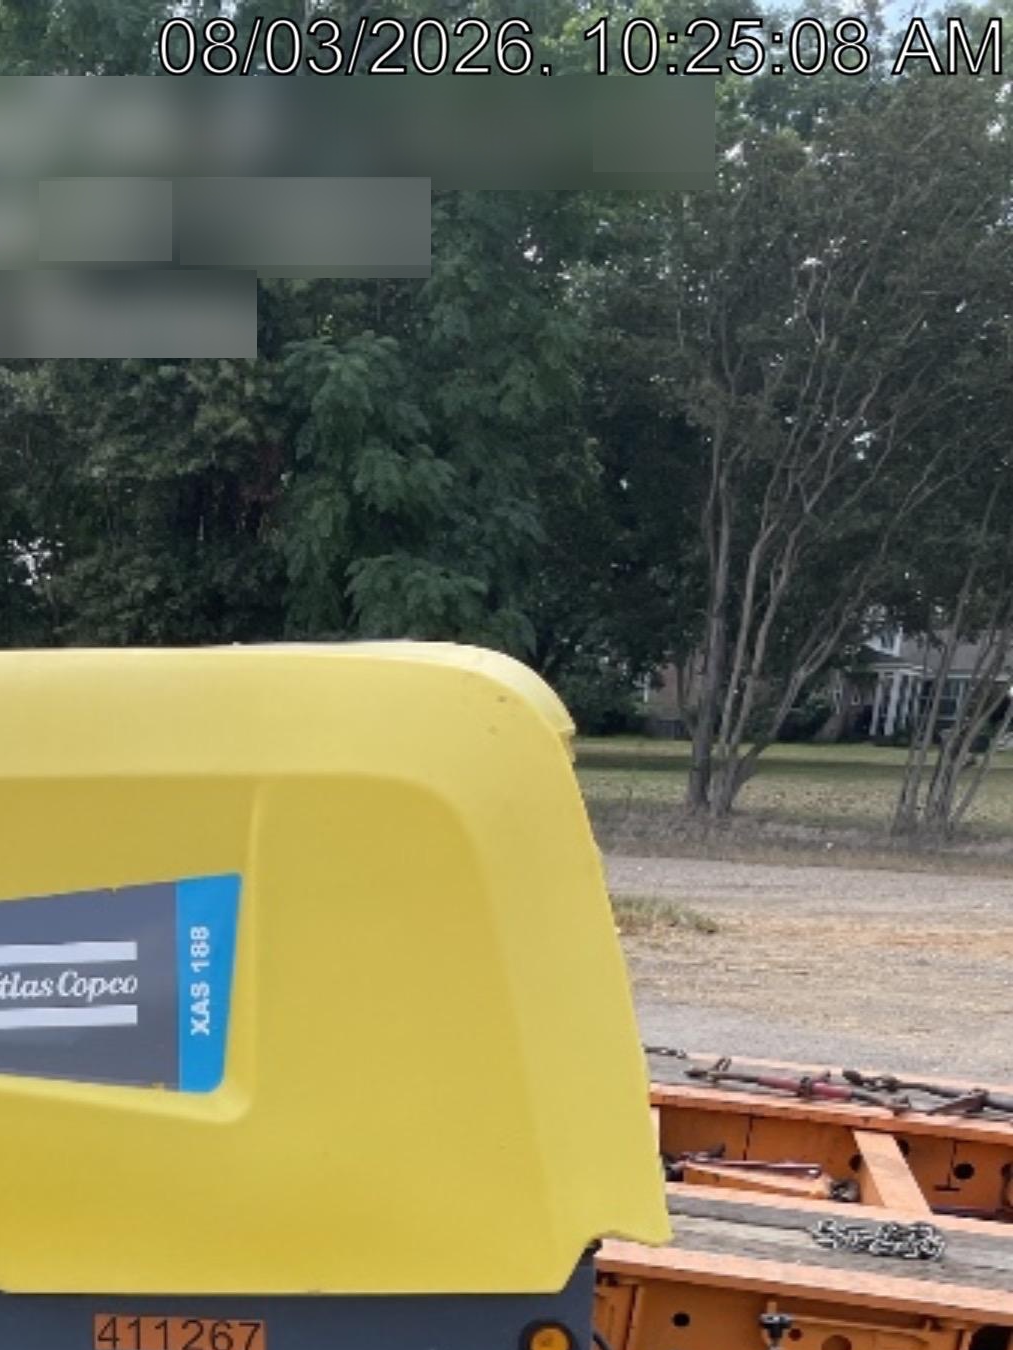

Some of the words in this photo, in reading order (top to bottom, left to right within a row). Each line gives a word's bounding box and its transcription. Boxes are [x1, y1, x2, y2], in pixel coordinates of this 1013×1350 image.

[190, 926, 210, 973] 188
[57, 970, 138, 1002] Copco
[190, 982, 210, 1036] XAS
